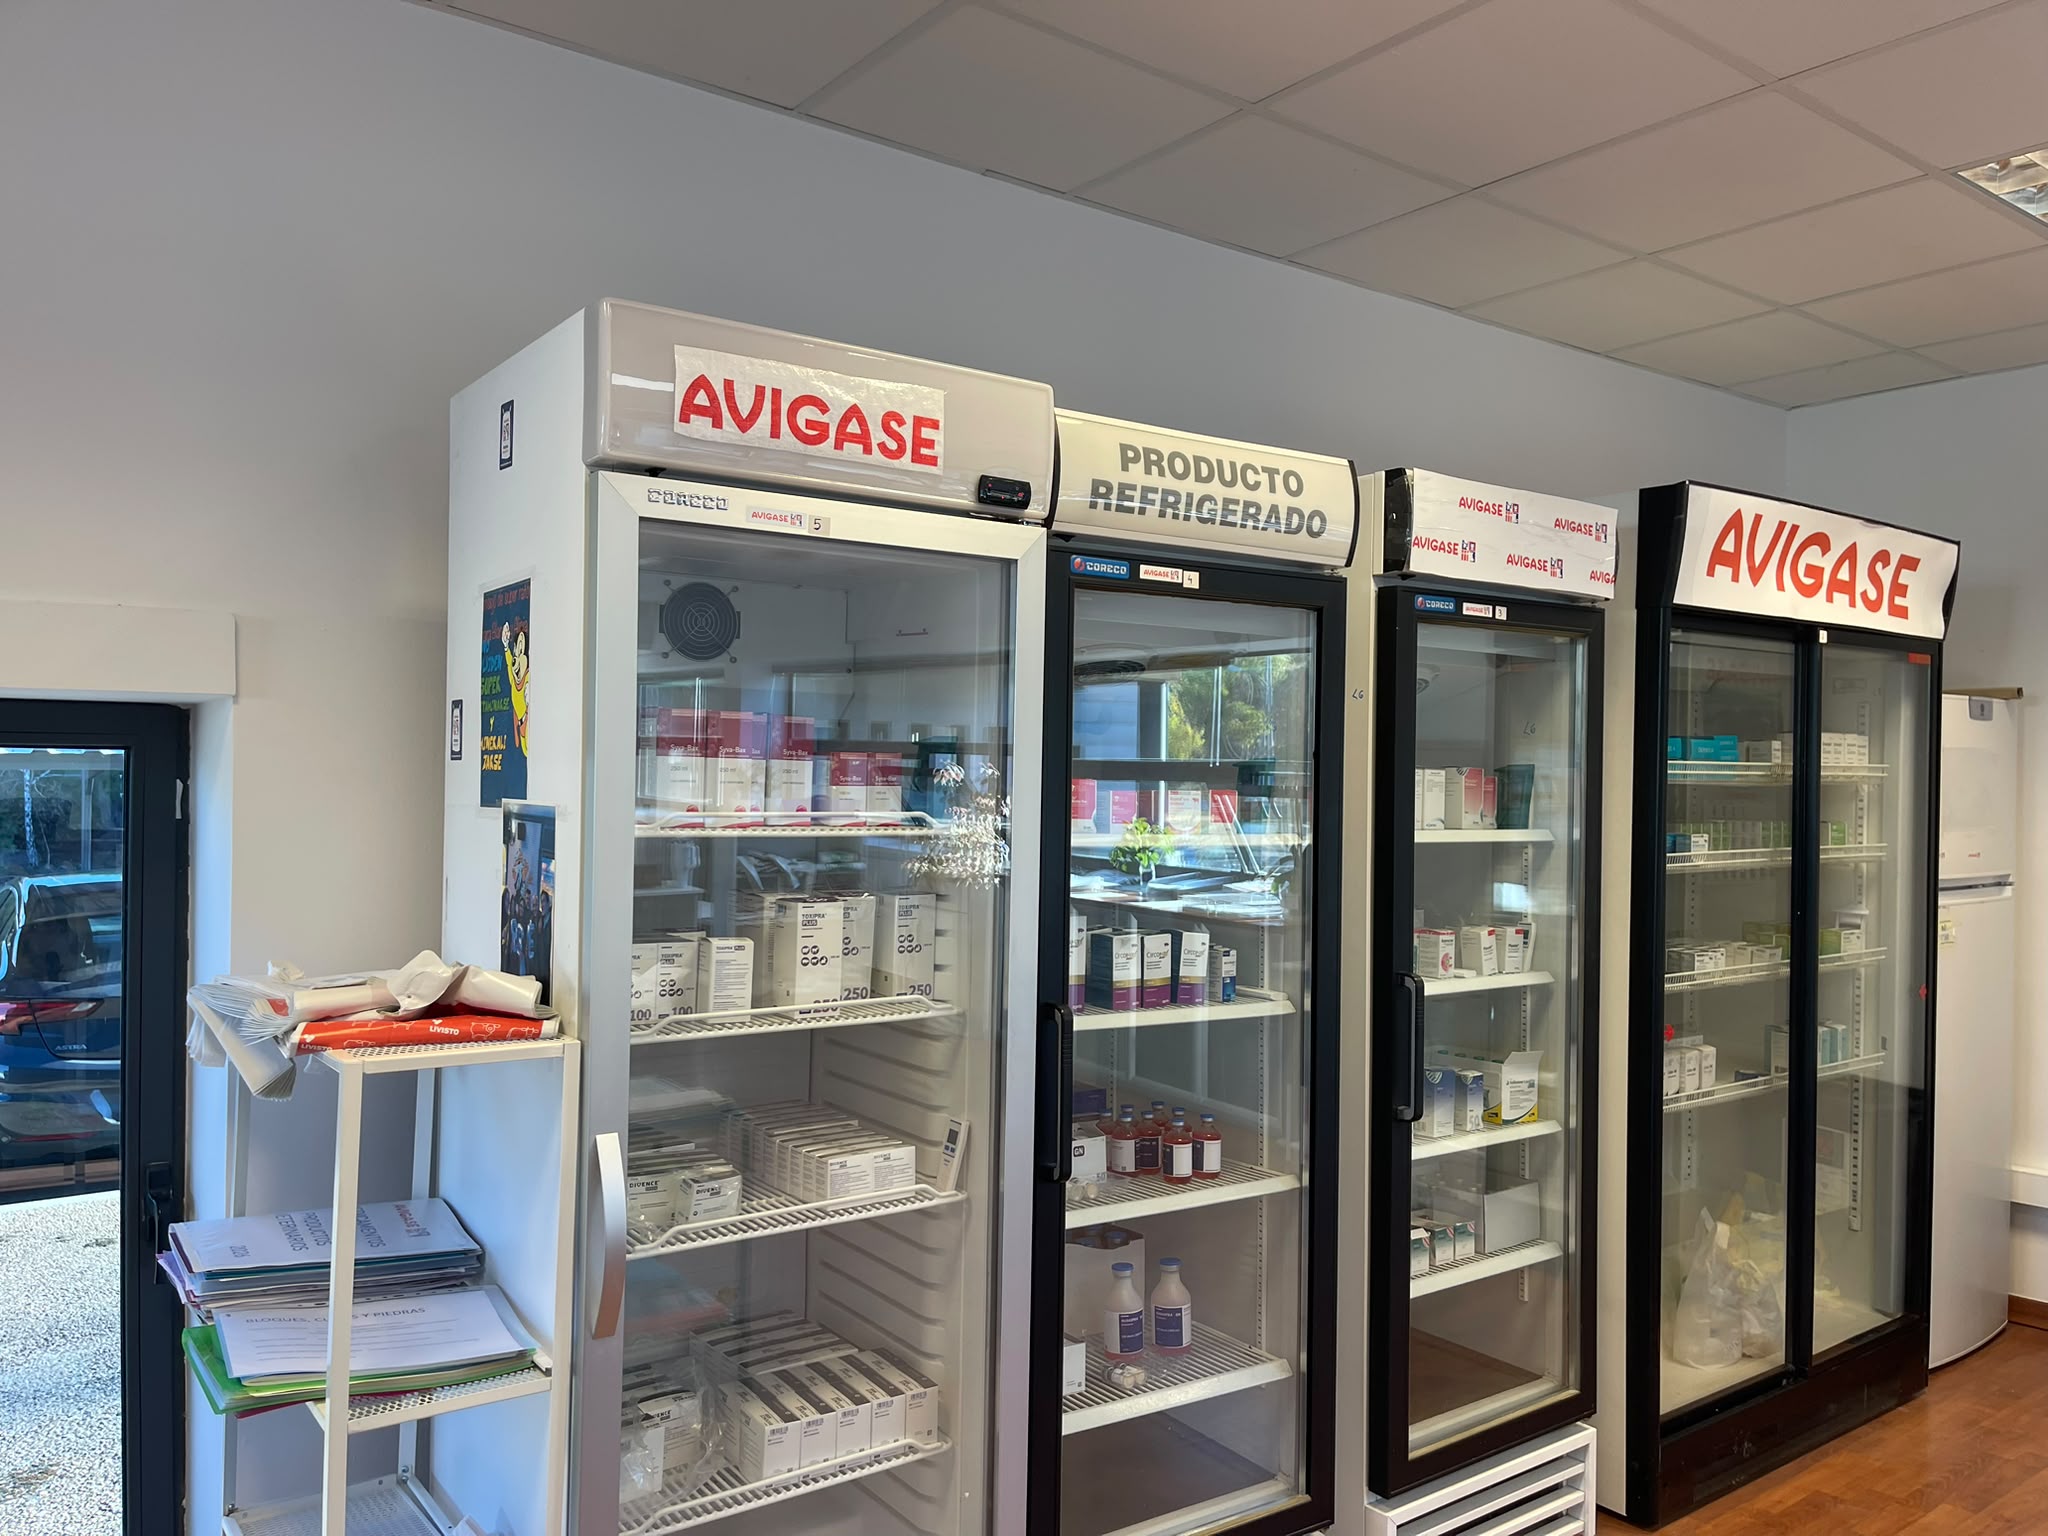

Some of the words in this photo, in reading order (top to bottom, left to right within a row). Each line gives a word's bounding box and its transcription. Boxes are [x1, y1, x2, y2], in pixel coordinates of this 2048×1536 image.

[678, 374, 941, 467] AVIGASE
[1118, 443, 1305, 498] PRODUCTO
[1089, 478, 1328, 540] REFRIGERADO
[1458, 495, 1504, 517] AVIGASE
[751, 511, 789, 523] AVIGASE
[813, 518, 822, 531] 5
[1553, 517, 1594, 537] AVIGASE
[1412, 535, 1460, 556] AVIGASE
[1086, 561, 1128, 575] CORECO
[1506, 552, 1549, 573] AVIGASE
[1706, 507, 1921, 620] AVIGASE
[1143, 568, 1170, 579] AVIGASE
[1425, 600, 1454, 610] CORECO
[719, 745, 746, 754] Syva-Bax
[782, 748, 809, 757] Syva-Bax
[844, 986, 869, 1001] 250
[907, 983, 932, 998] 250
[428, 1025, 460, 1036] LIVISTO
[54, 1042, 87, 1052] ASTRA
[372, 1306, 426, 1318] PIEDRAS
